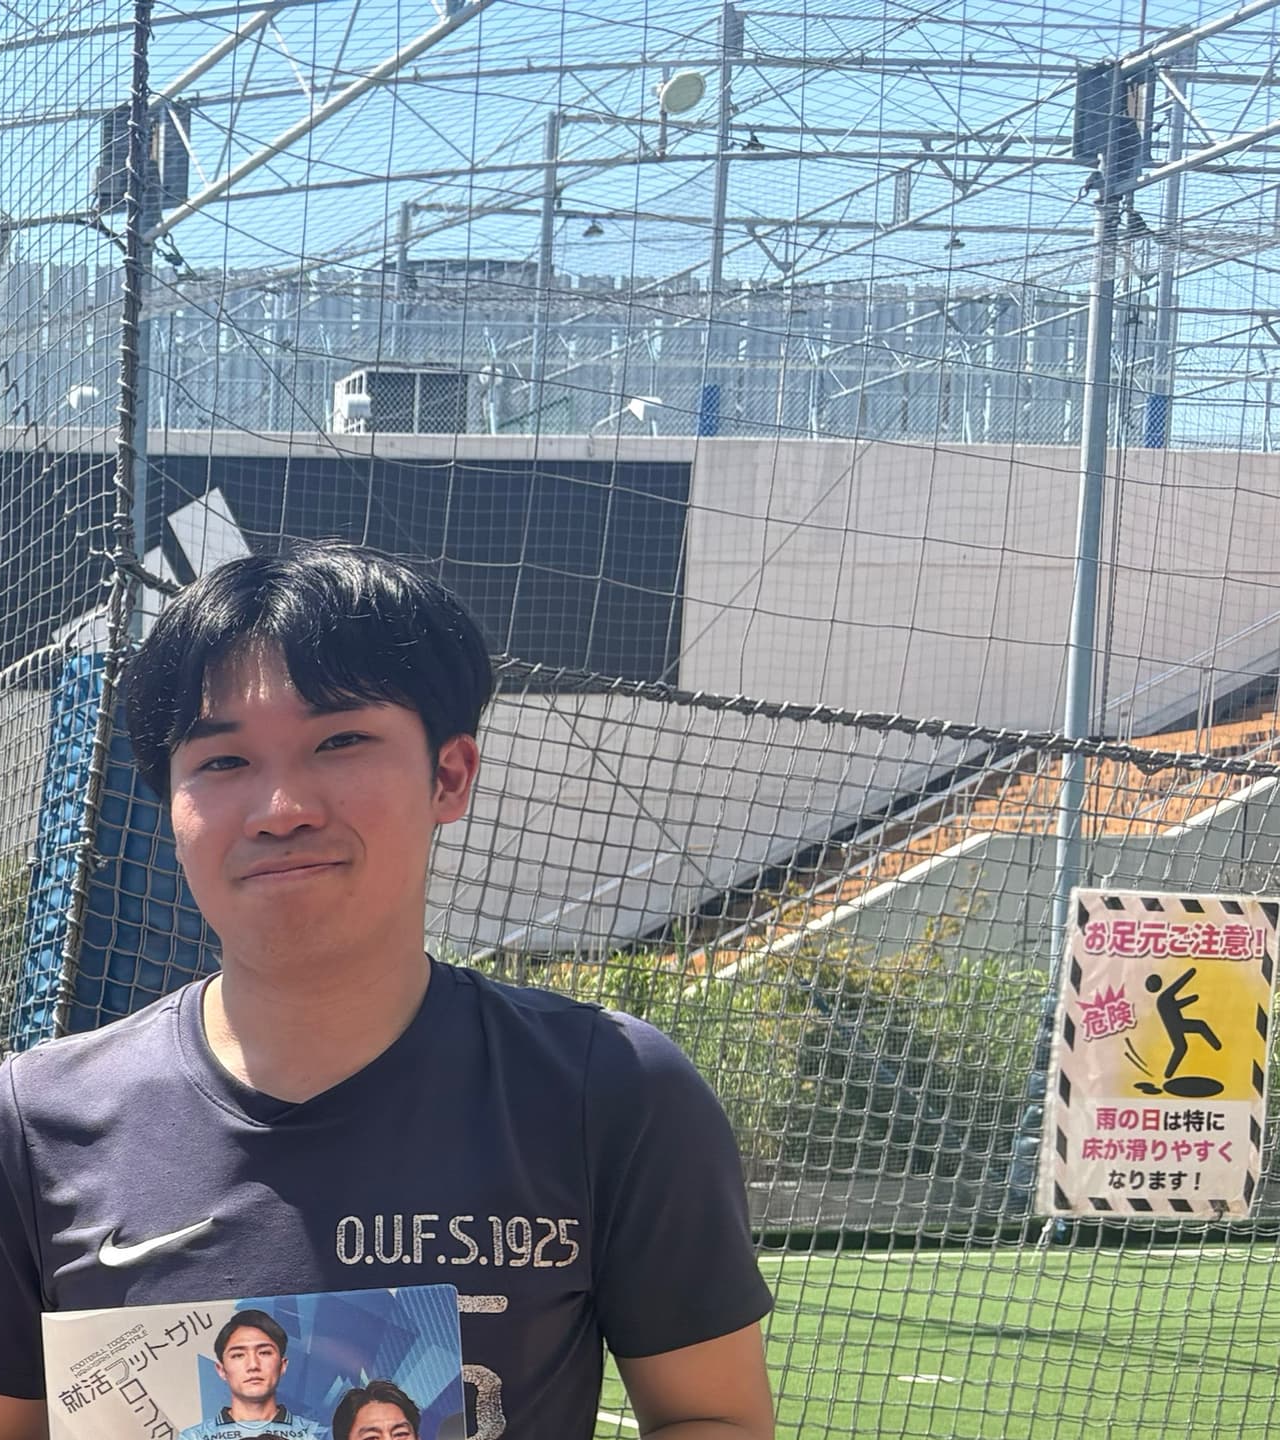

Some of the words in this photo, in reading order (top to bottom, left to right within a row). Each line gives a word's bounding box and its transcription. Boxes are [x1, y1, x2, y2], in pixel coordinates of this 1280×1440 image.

[1084, 921, 1267, 957] お足元ご注意！
[1081, 1001, 1137, 1040] 危険
[1095, 1109, 1226, 1133] 雨の日は特に
[1081, 1139, 1234, 1163] 床が滑りやすく
[1108, 1170, 1202, 1191] なります！
